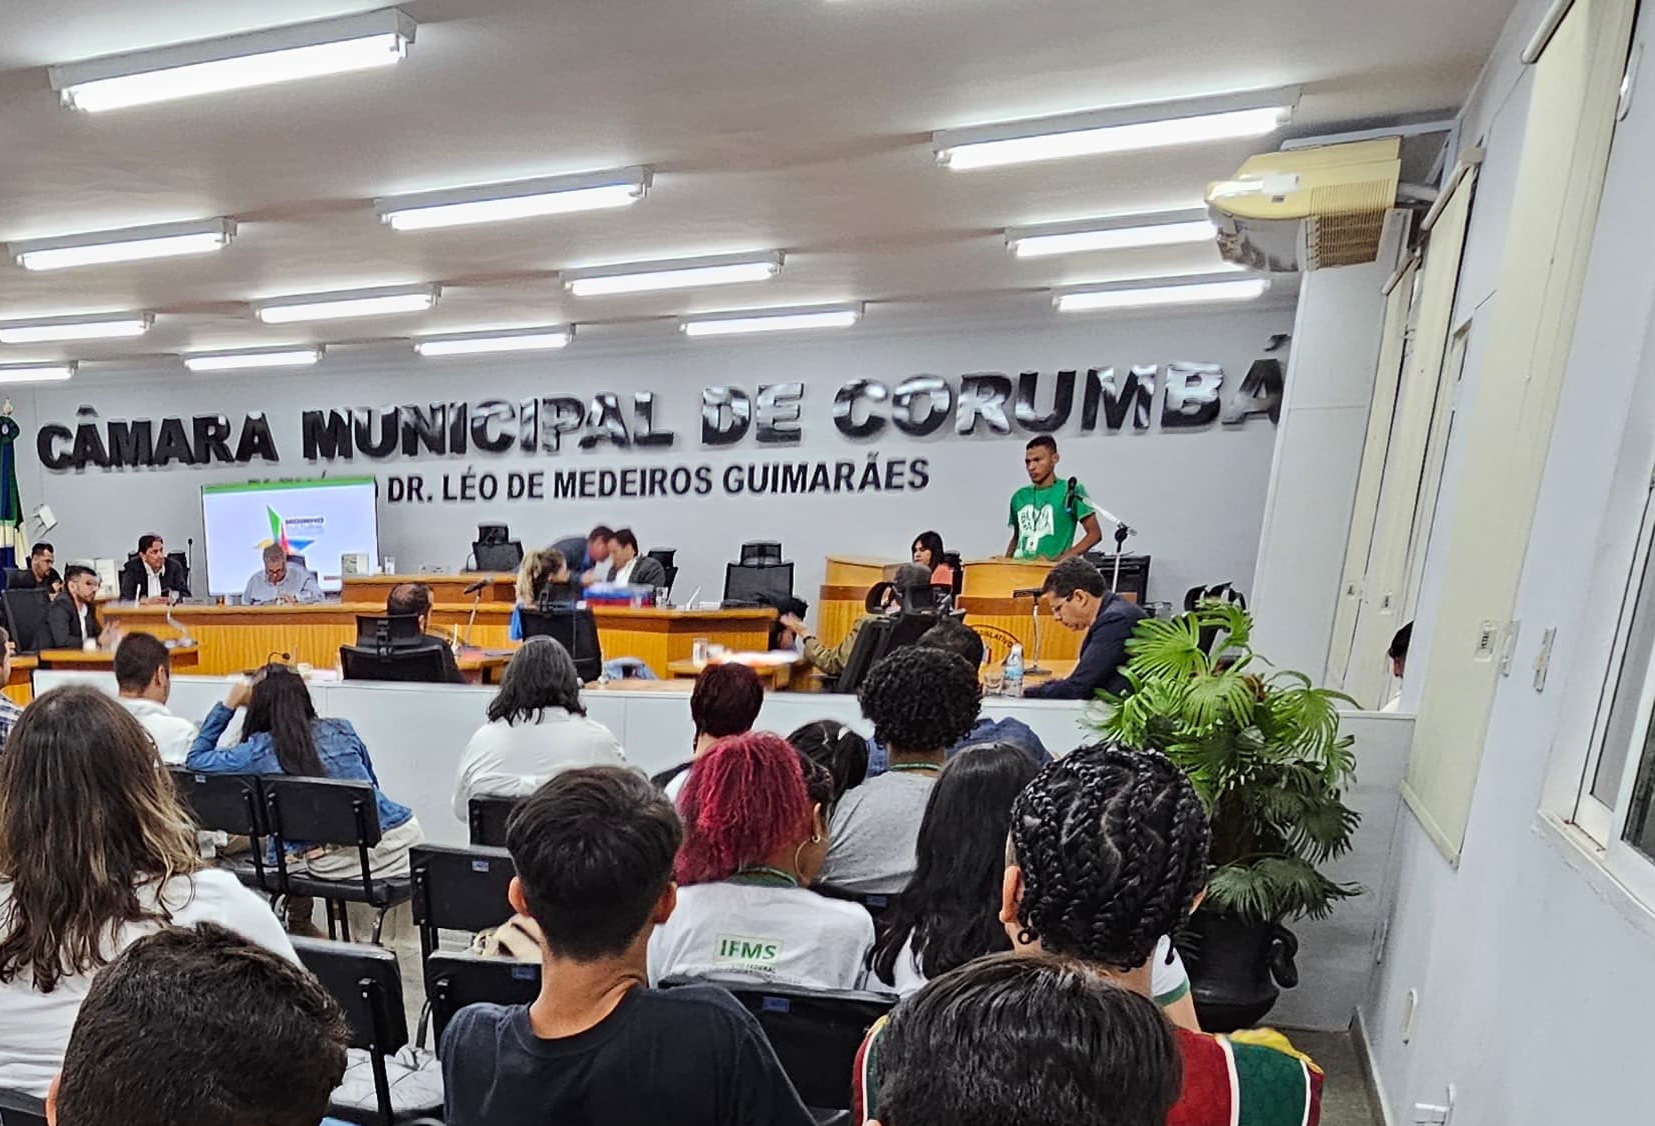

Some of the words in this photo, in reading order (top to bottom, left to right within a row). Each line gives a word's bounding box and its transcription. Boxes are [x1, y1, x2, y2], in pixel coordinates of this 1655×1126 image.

[36, 404, 280, 470] CÂMARA
[302, 393, 675, 461] MUNICIPAL
[701, 382, 804, 445] DE
[832, 333, 1289, 440] CORUMBÁ
[387, 474, 433, 503] DR.
[442, 465, 498, 501] LÉO
[507, 471, 544, 500] DE
[553, 465, 712, 500] MEDEIROS
[722, 451, 930, 494] GUIMARÃES
[719, 938, 778, 960] IFMS
